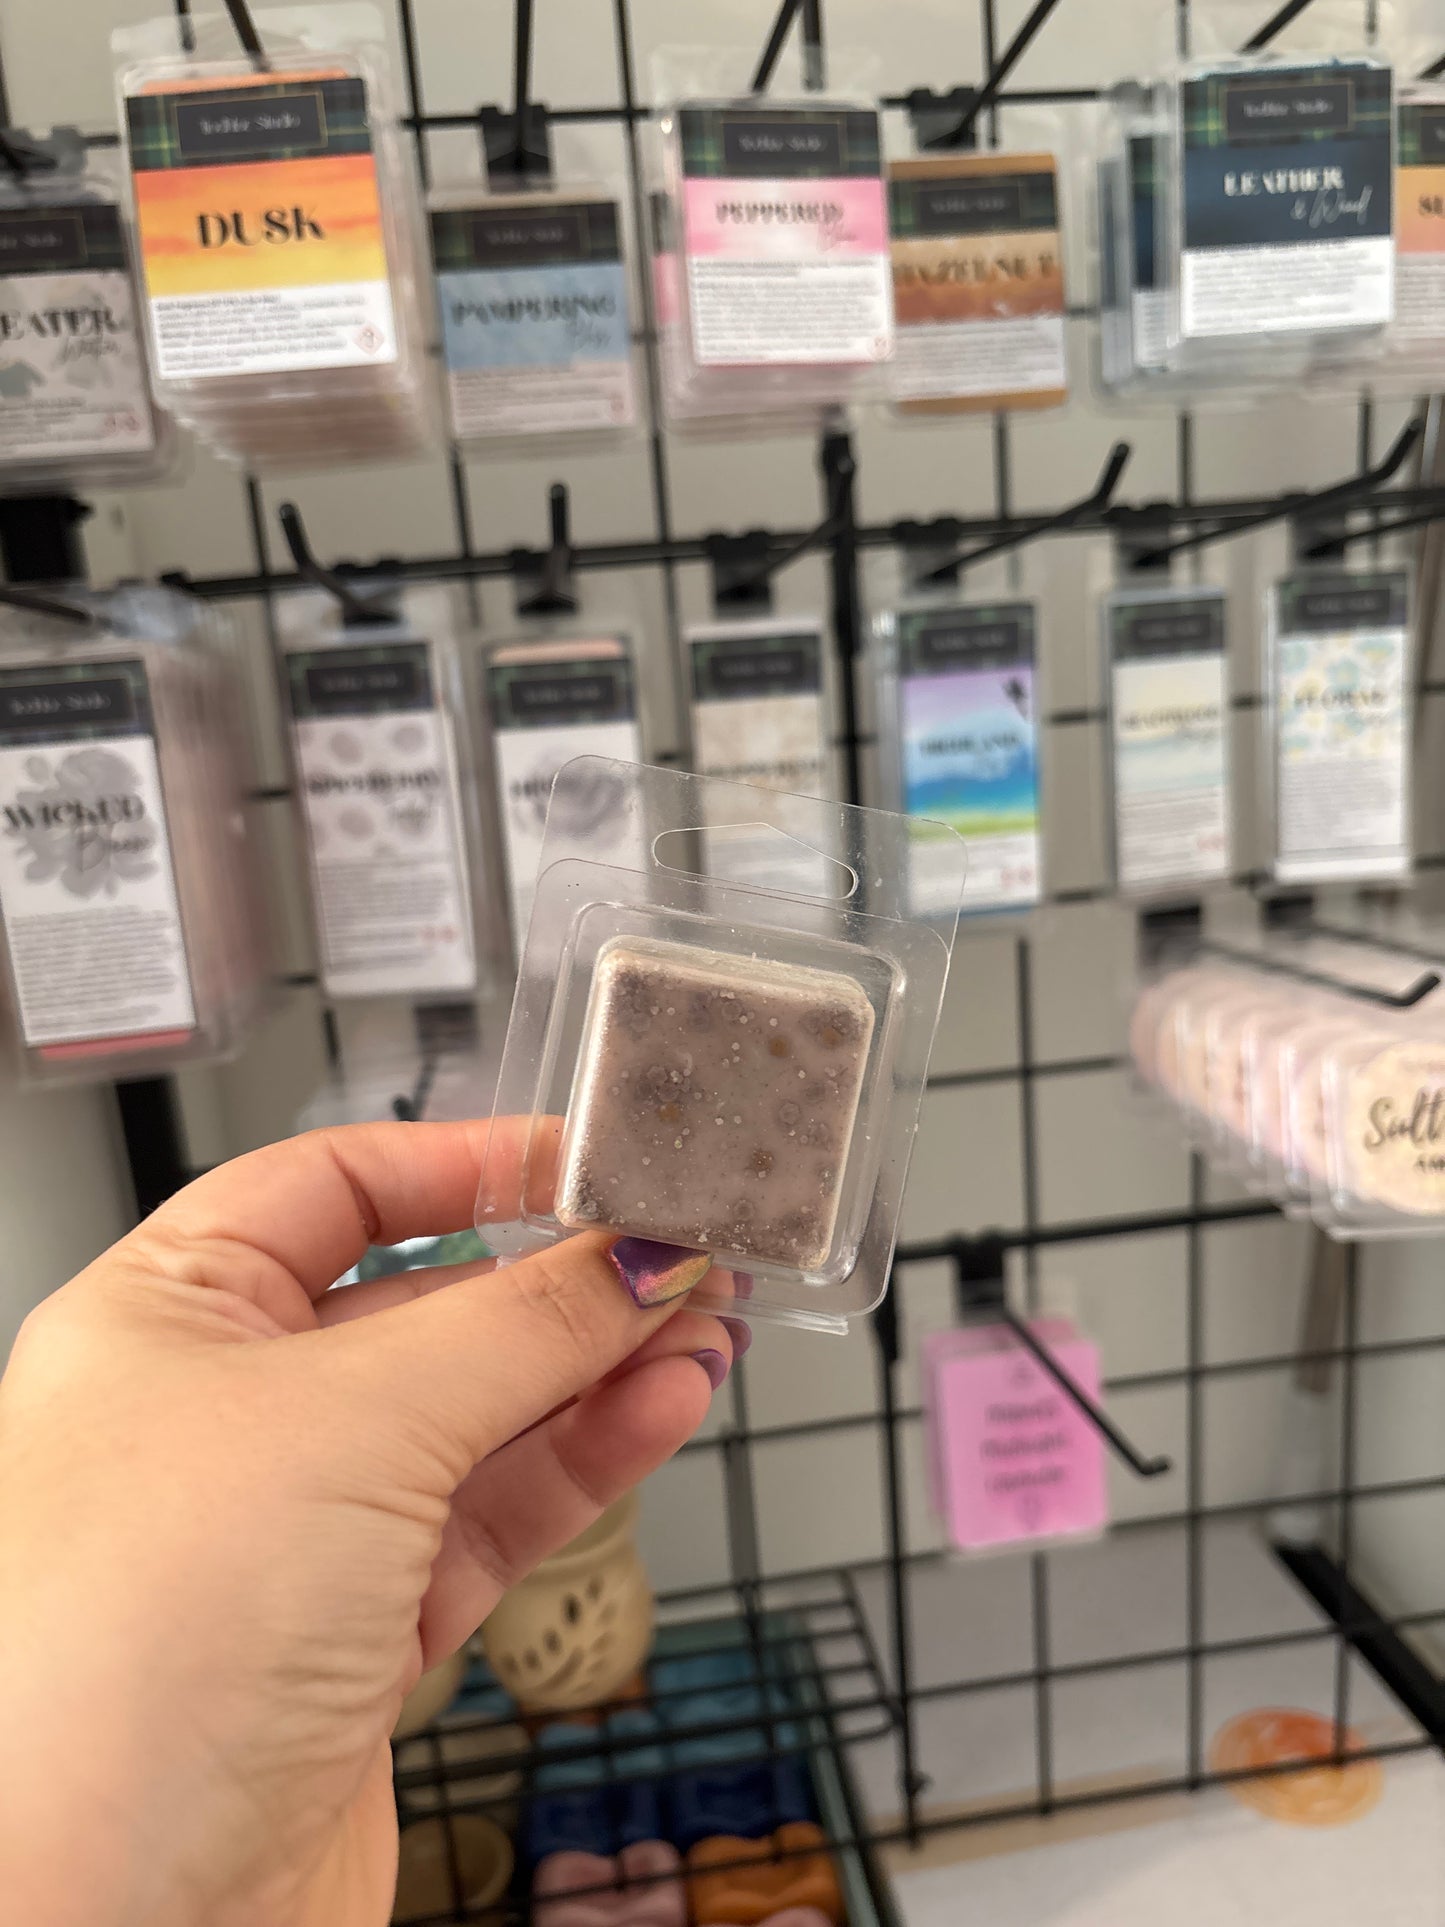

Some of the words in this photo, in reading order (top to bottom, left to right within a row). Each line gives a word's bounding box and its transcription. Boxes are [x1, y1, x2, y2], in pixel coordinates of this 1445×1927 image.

[1223, 166, 1345, 197] LEATHER
[197, 205, 326, 249] DUSK
[3, 793, 146, 835] WICKED
